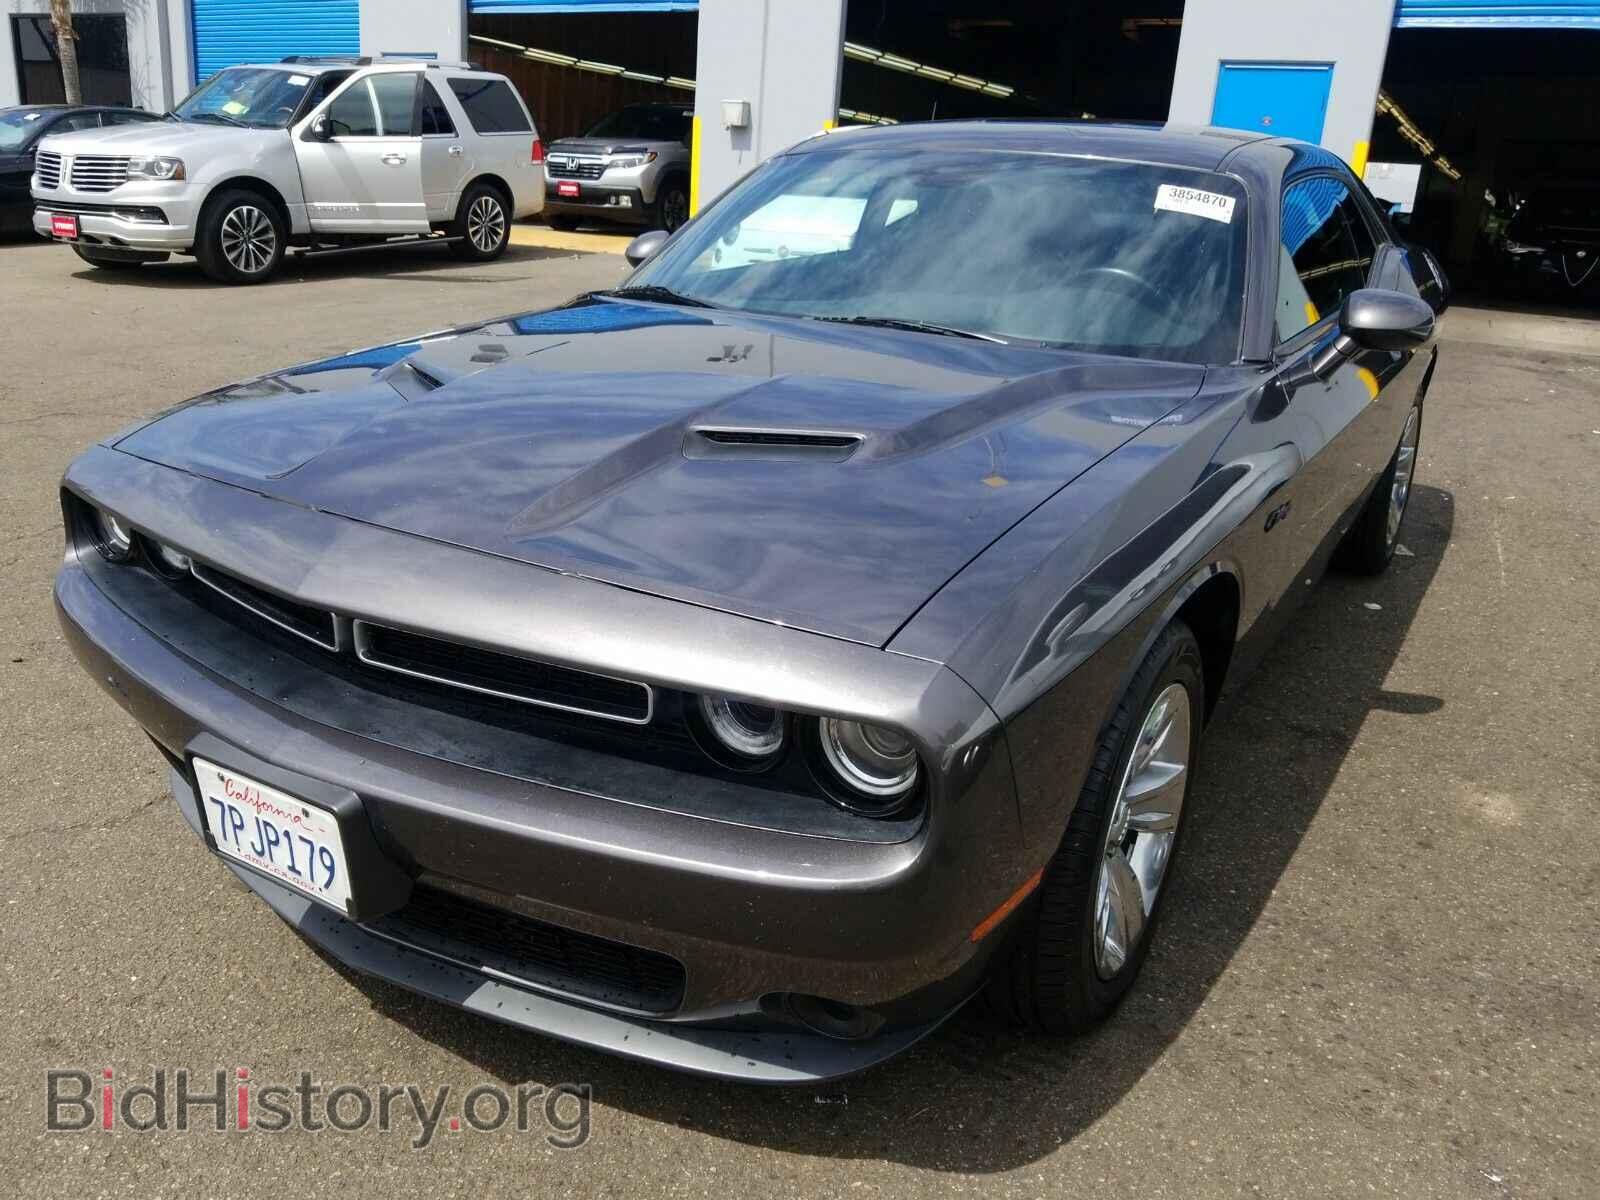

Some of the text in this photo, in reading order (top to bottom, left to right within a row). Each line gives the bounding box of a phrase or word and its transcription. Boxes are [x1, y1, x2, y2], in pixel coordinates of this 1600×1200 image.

[1168, 187, 1227, 208] 3854870
[223, 778, 313, 832] California
[209, 796, 336, 890] 7PJP179
